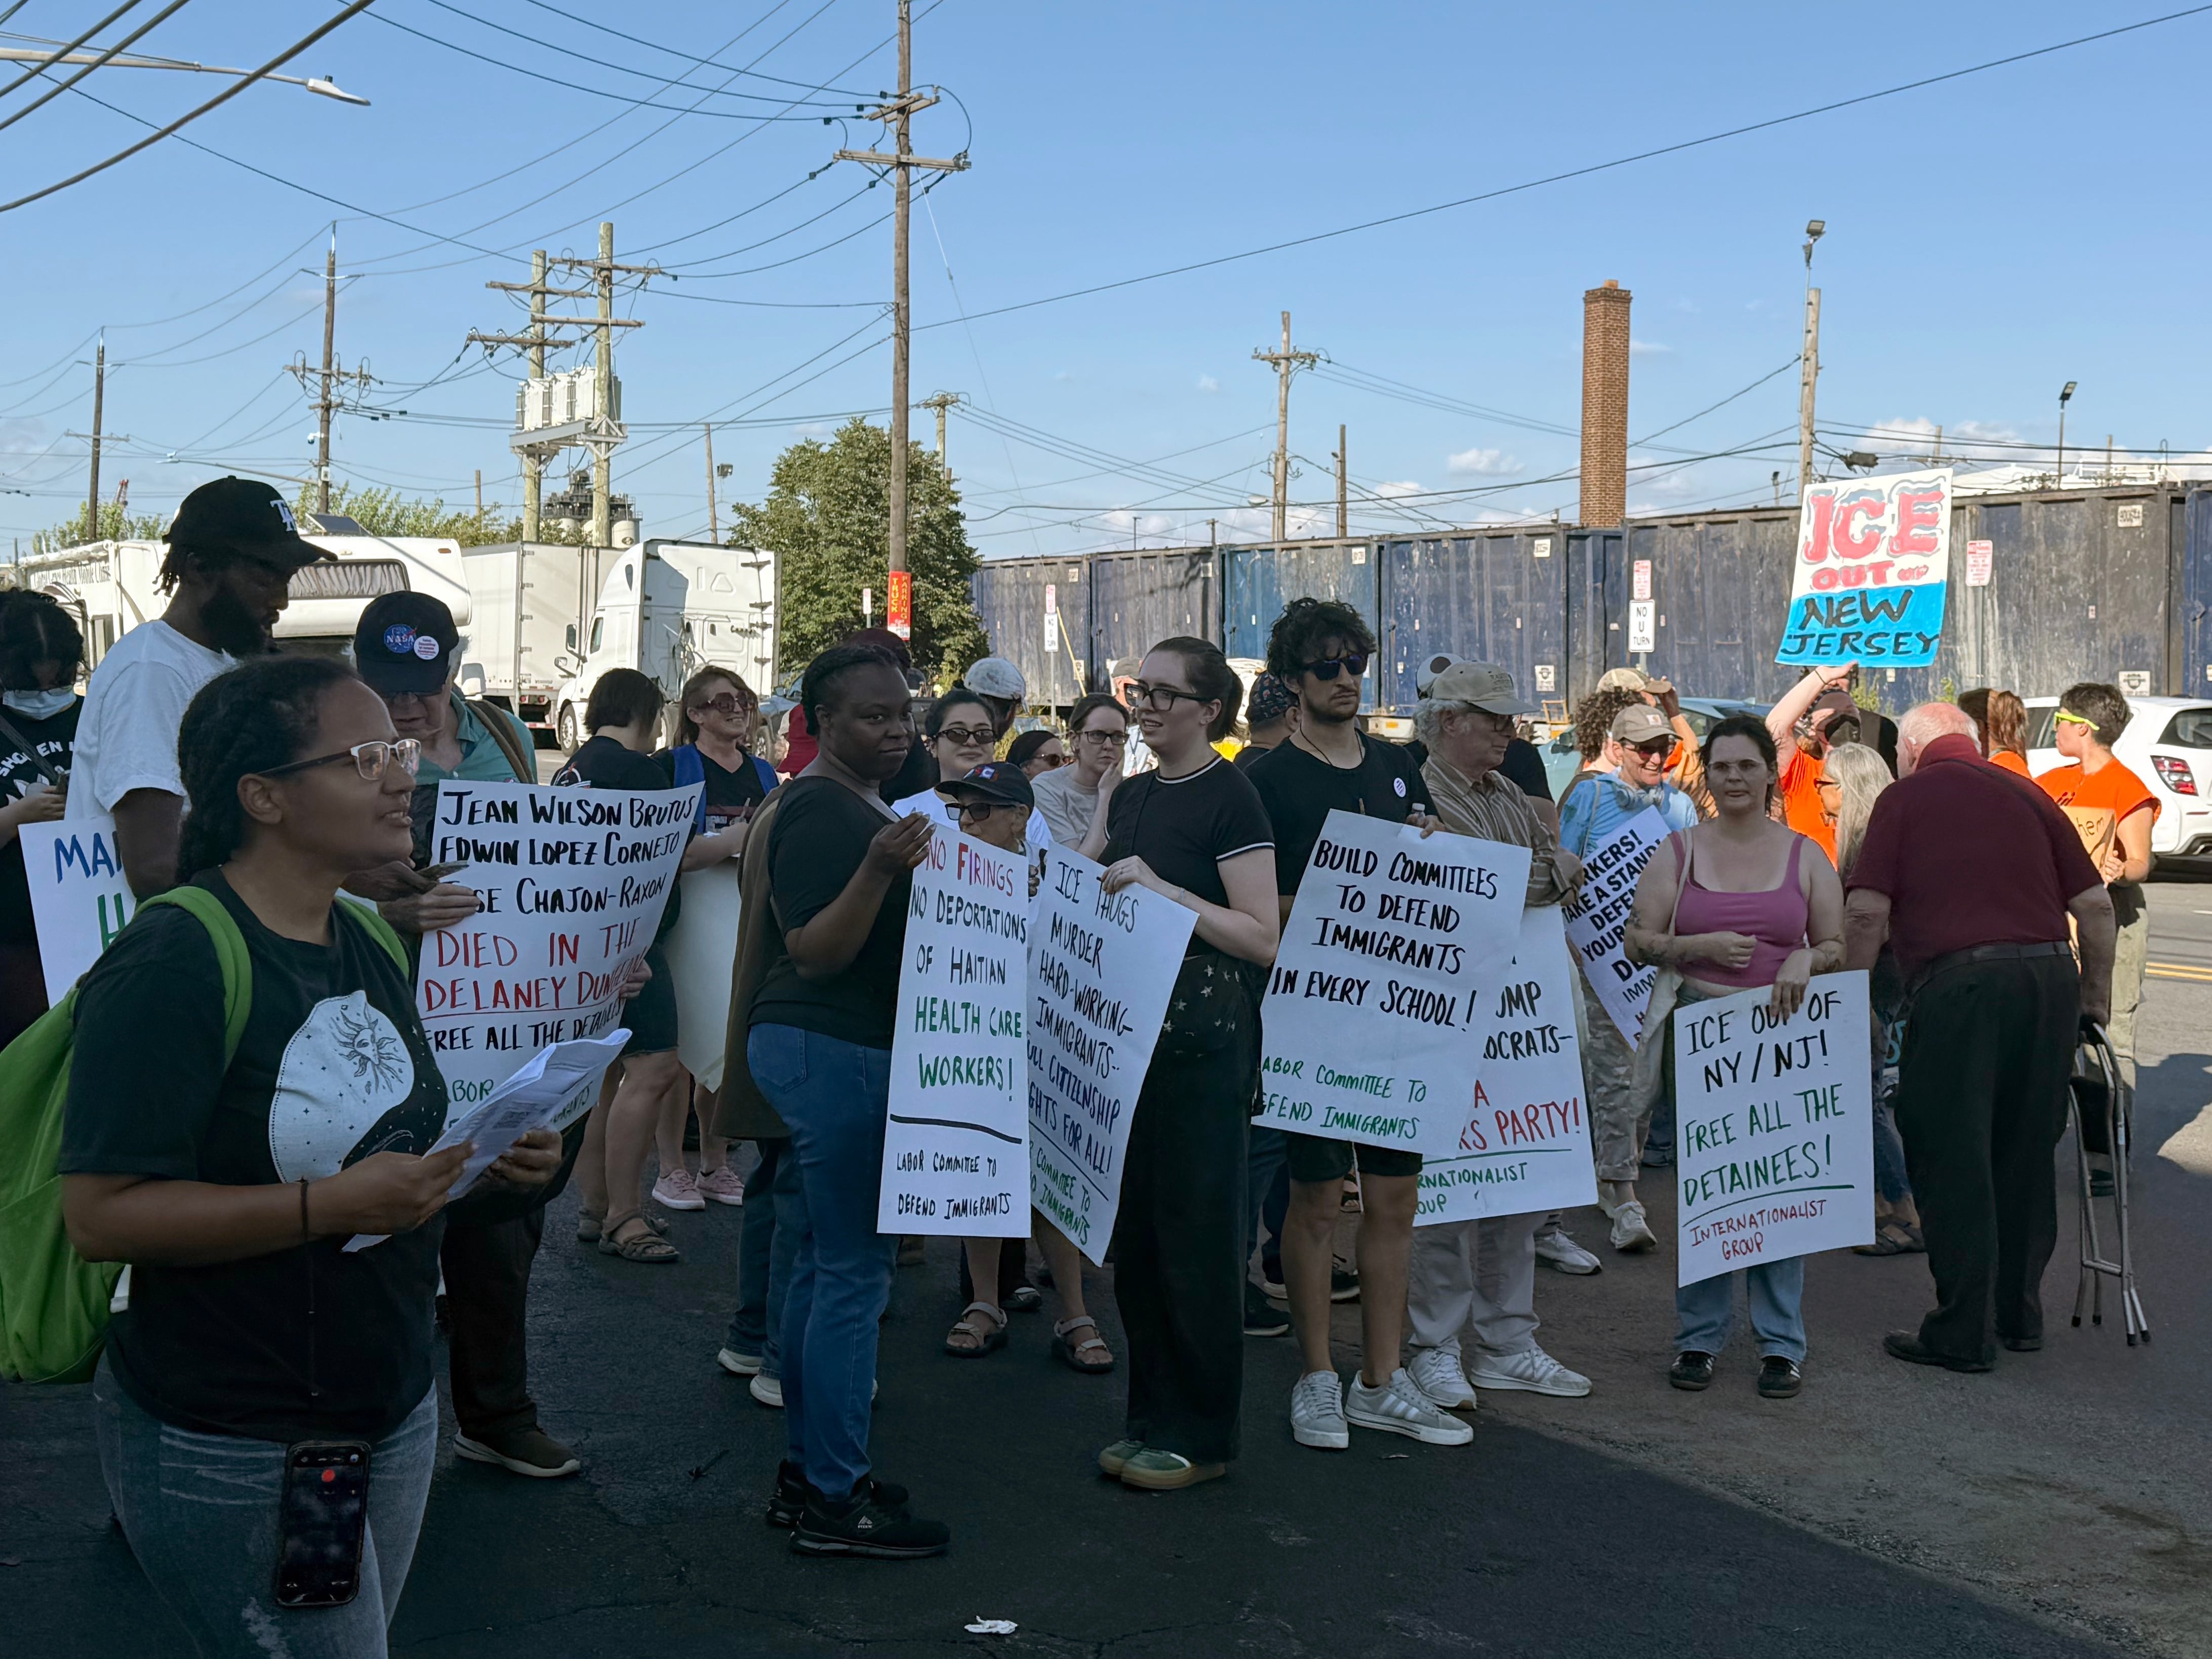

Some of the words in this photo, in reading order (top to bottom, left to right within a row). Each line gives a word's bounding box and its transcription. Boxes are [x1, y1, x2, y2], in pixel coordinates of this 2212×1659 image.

[891, 577, 899, 613] TRUCK
[1812, 560, 1895, 590] OUT
[1898, 565, 1929, 581] OF
[1636, 606, 1647, 617] NO
[1638, 621, 1644, 633] U
[1798, 590, 1914, 630] NEW
[387, 635, 415, 643] NASA
[1633, 636, 1650, 646] TURN
[1780, 631, 1940, 656] JERSEY
[0, 741, 63, 777] SHOEN
[441, 791, 518, 825] JEAN
[529, 793, 623, 825] WILSON
[629, 795, 696, 828] BRUTUS
[529, 839, 599, 866] LOPEZ
[604, 831, 680, 866] CORNEJO
[926, 837, 947, 872] NO
[957, 842, 1013, 897] FIRINGS
[1583, 829, 1643, 886] RKERS!
[1055, 861, 1083, 904] ICE
[1313, 840, 1378, 878] BUILD
[1388, 851, 1499, 900] COMMITTEES
[910, 884, 927, 920] NO
[937, 889, 1026, 944] DEPORTATIONS
[1336, 884, 1366, 913] TO
[1377, 893, 1460, 933] DEFEND
[1594, 885, 1611, 904] A
[436, 930, 517, 968] DIED
[550, 932, 579, 967] IN
[917, 944, 933, 974] OF
[950, 946, 1006, 985] HAITIAN
[1050, 911, 1103, 979] MURDER
[1311, 917, 1466, 975] IMMIGRANTS
[425, 976, 567, 1011] DELANEY
[1271, 967, 1299, 996] IN
[1304, 971, 1370, 1006] EVERY
[1379, 979, 1477, 1032] SCHOOL!
[486, 1024, 523, 1050] ALL
[528, 1019, 566, 1048] THE
[915, 996, 980, 1034] HEALTH
[989, 1006, 1022, 1038] CARE
[1685, 1010, 1735, 1056] ICE
[1808, 991, 1841, 1022] OF
[451, 1079, 493, 1104] BOR
[918, 1053, 1013, 1102] WORKERS!
[1027, 1039, 1043, 1072] ULL
[1049, 1055, 1120, 1135] CITIZENSHIP
[1262, 1055, 1304, 1079] ABOR
[1316, 1064, 1394, 1098] COMMITTEE
[1407, 1079, 1427, 1103] TO
[1474, 1079, 1490, 1109] A
[1028, 1081, 1058, 1131] GHTS
[1063, 1113, 1082, 1157] FOR
[1084, 1133, 1113, 1179] ALL!
[1263, 1092, 1313, 1121] FEND
[1319, 1105, 1420, 1139] IMMIGRANTS
[1494, 1097, 1580, 1146] PARTY!
[1685, 1113, 1737, 1158] FREE
[1749, 1100, 1791, 1137] ALL
[1793, 1083, 1845, 1123] THE
[897, 1149, 924, 1172] LABOR
[933, 1152, 980, 1173] COMMITTEE
[987, 1158, 997, 1177] TO
[1036, 1147, 1077, 1201] COMMITTEE
[1081, 1184, 1091, 1212] TO
[1417, 1162, 1527, 1189] RNATIONALIST
[1683, 1134, 1831, 1207] DETAINEES!
[898, 1193, 936, 1216] DEFEND
[944, 1192, 1012, 1219] IMMIGRANTS
[1039, 1183, 1091, 1246] IMMIGRANTS
[1416, 1193, 1447, 1215] OUP
[1690, 1199, 1827, 1247] INTERNATIONALIST
[1722, 1233, 1764, 1260] GROUP
